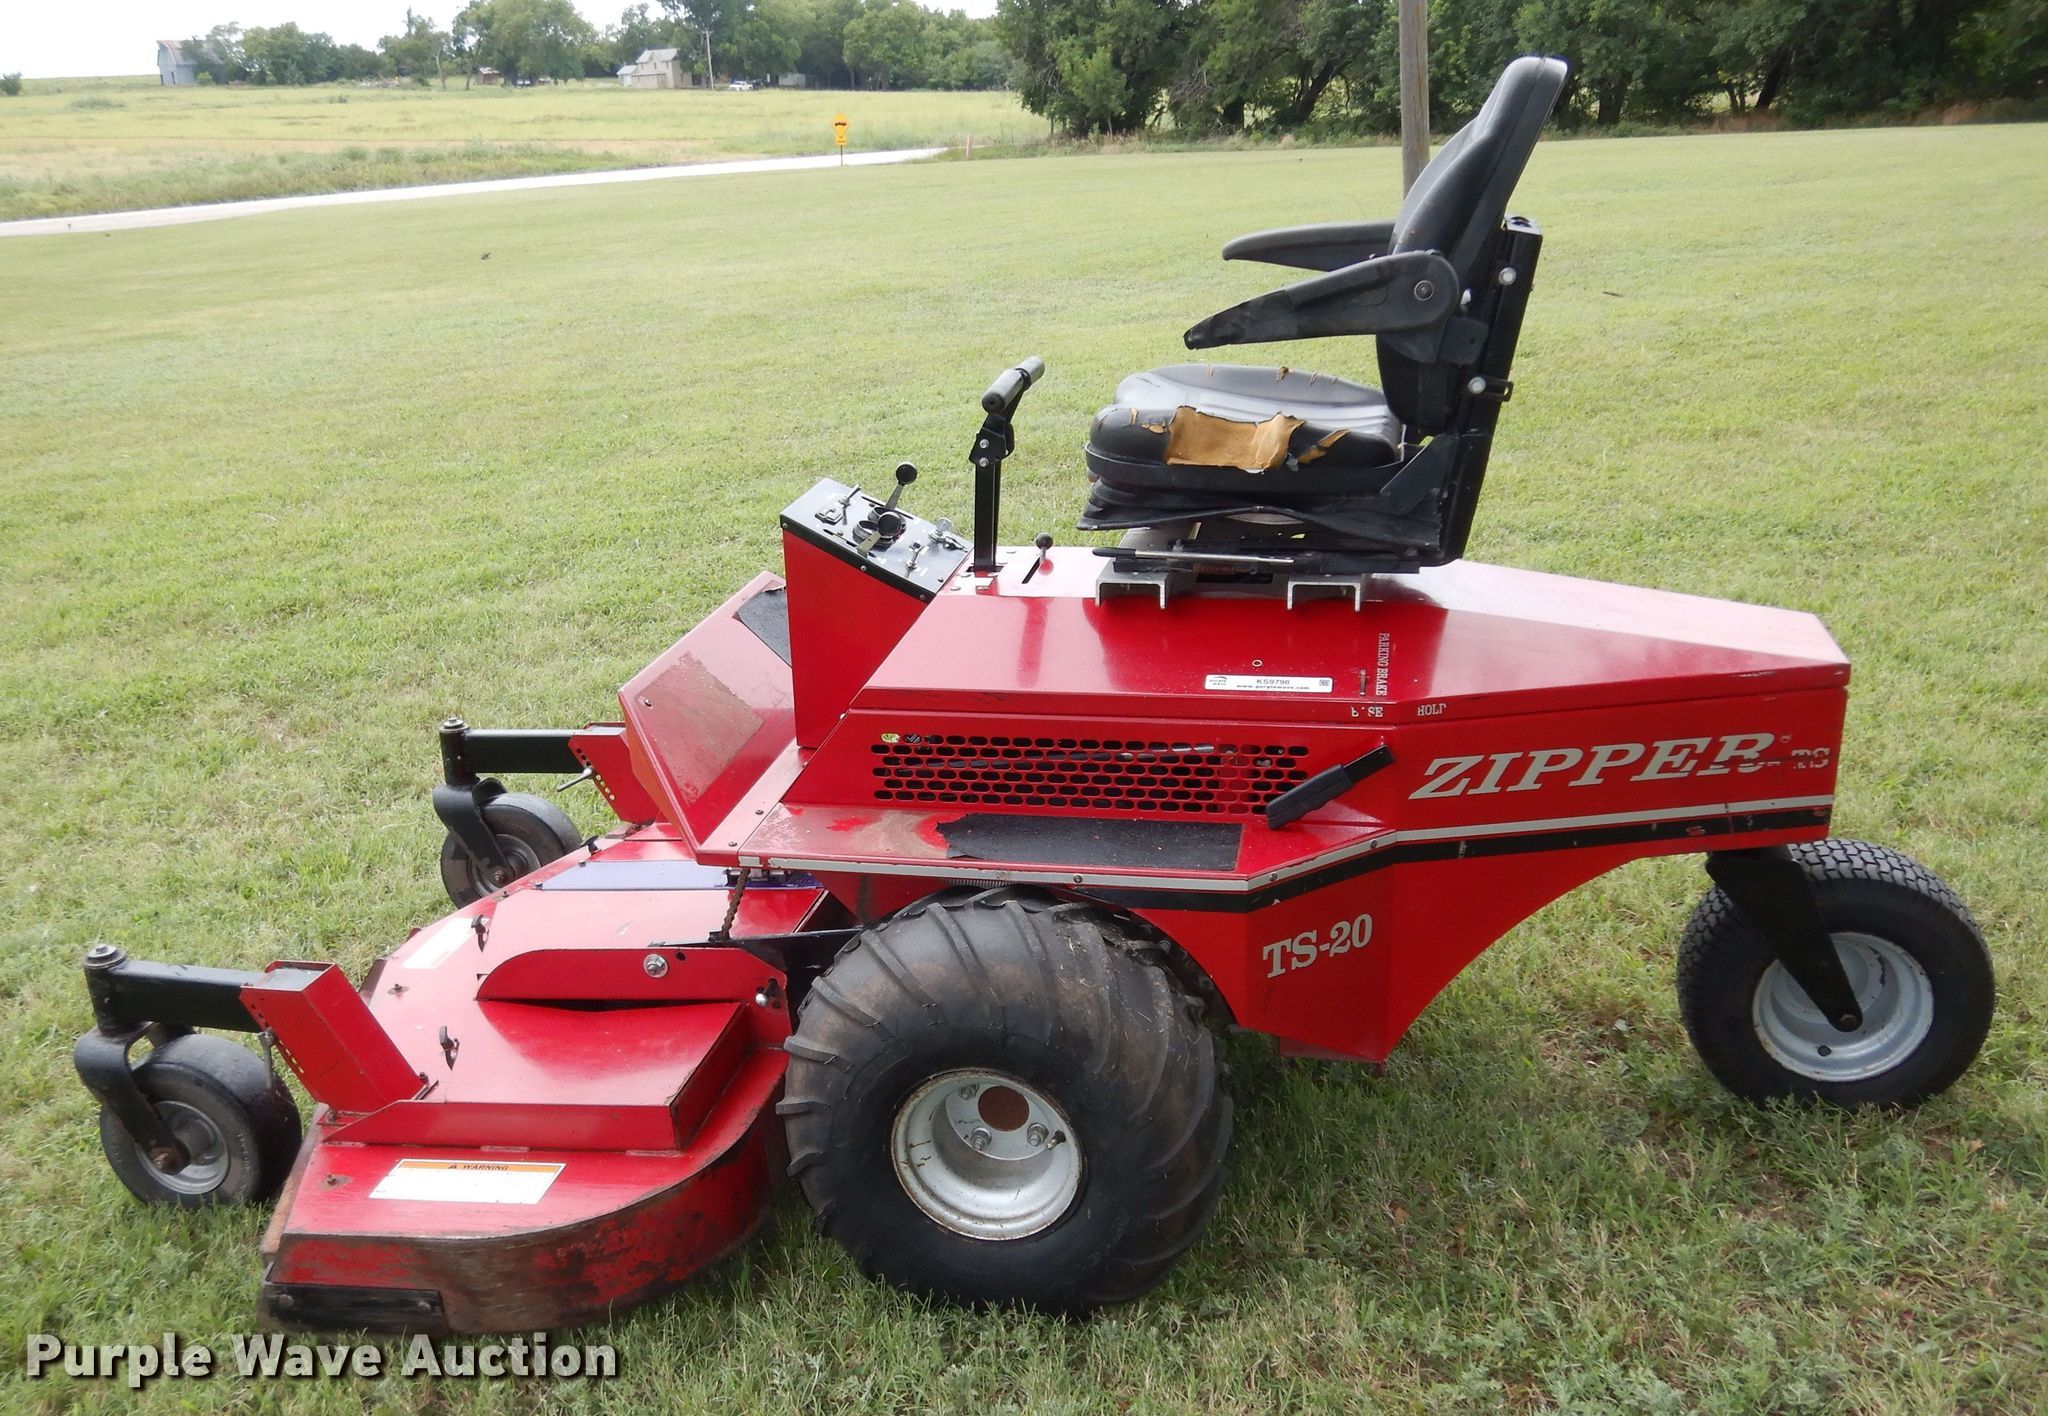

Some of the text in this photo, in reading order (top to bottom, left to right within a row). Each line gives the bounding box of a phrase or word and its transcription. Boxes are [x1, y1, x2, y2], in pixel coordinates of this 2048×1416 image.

[1375, 632, 1390, 696] PARKING BRAKE
[1408, 732, 1776, 800] ZIPPER
[1262, 913, 1373, 979] TS-20
